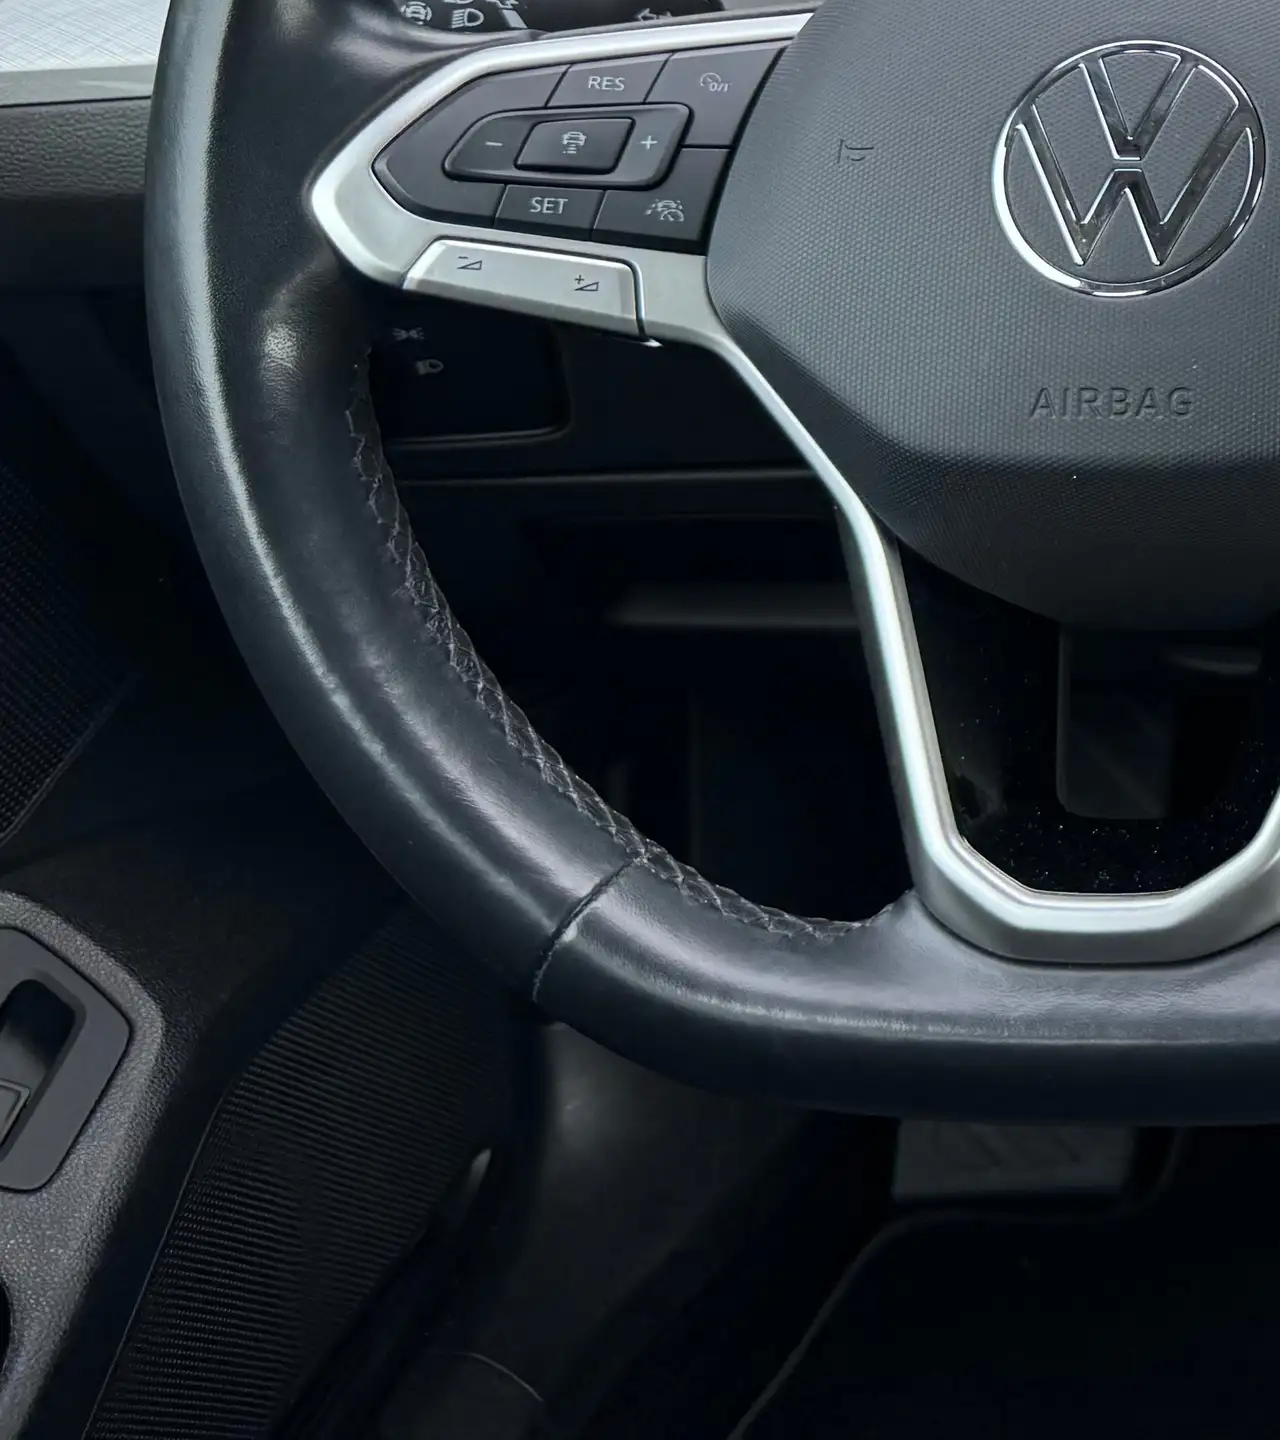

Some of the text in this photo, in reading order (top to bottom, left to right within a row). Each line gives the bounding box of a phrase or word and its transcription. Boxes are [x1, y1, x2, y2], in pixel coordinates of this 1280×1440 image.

[588, 75, 626, 92] RES
[529, 197, 568, 215] SET
[1029, 386, 1197, 419] AIRBAG
